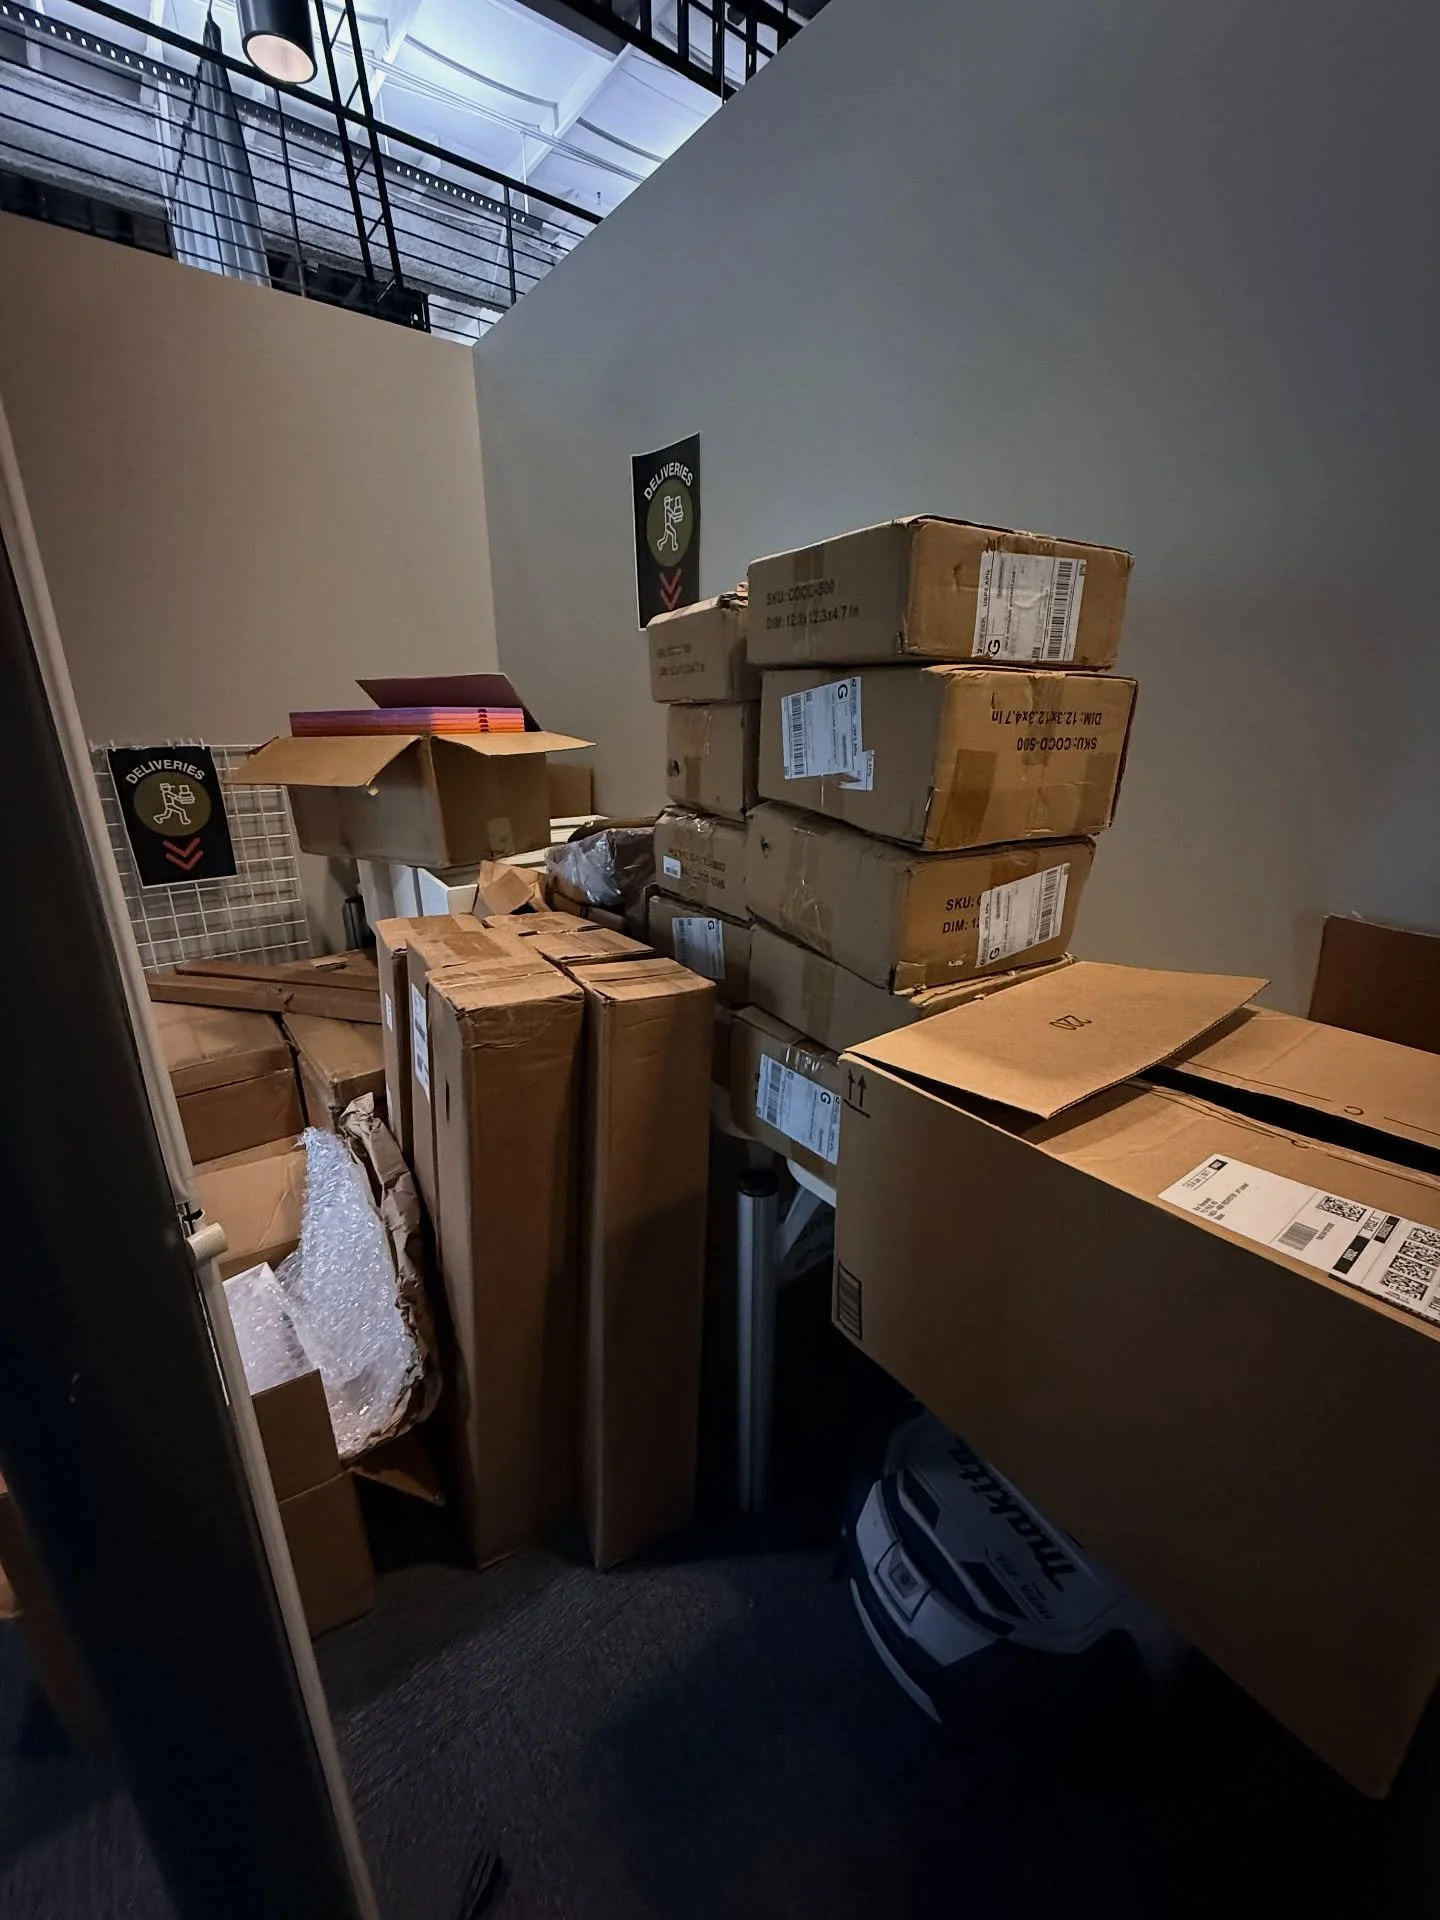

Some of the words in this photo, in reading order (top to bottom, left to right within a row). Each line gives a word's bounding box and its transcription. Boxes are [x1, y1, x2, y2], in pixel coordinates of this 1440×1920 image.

[643, 462, 693, 501] DELIVERIES
[766, 590, 785, 606] SKU:
[988, 639, 1000, 655] G
[837, 683, 848, 700] G
[1081, 711, 1102, 725] DIM:
[1016, 736, 1071, 751] COCO-500
[1074, 736, 1098, 750] SKU:
[125, 759, 206, 785] DELIVERIES
[945, 896, 974, 911] SKU:
[942, 918, 968, 933] DIM:
[989, 947, 1000, 960] G
[1049, 1014, 1092, 1030] 220
[820, 1091, 831, 1105] G
